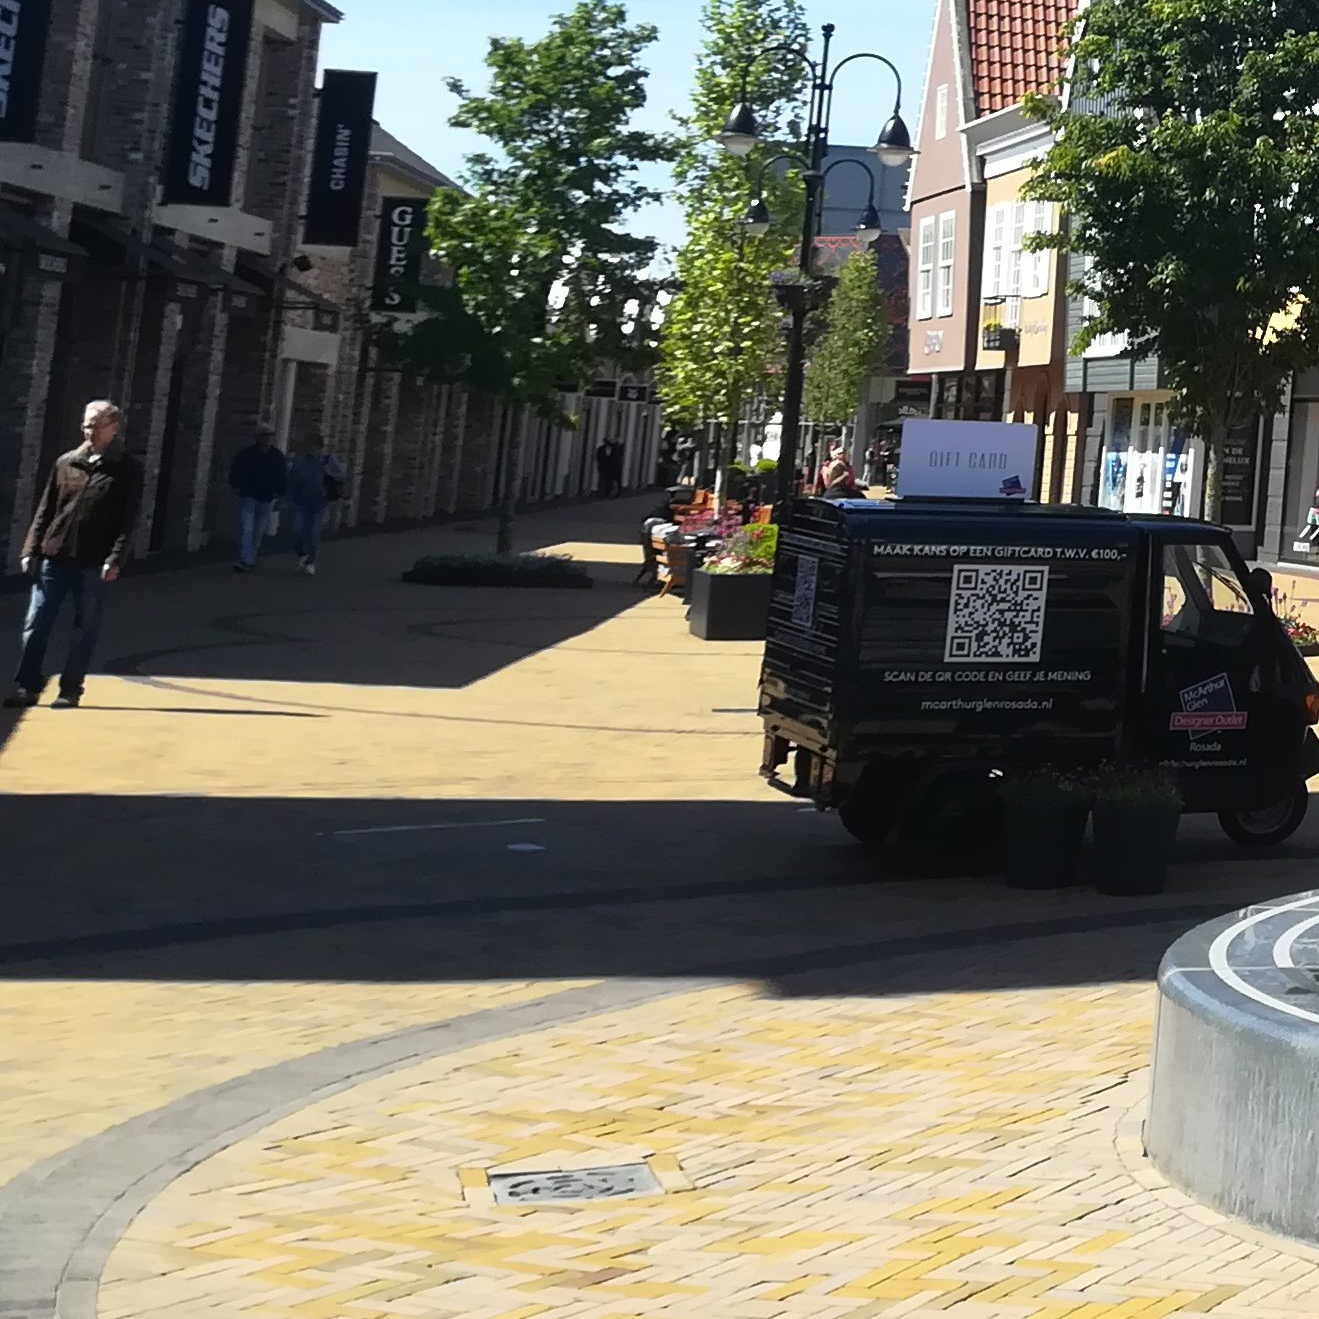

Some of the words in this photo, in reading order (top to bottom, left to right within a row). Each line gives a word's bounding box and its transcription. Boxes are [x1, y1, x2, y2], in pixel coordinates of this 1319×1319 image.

[188, 3, 230, 191] SKECHERS
[928, 449, 960, 468] GIFT
[968, 452, 1008, 470] CARD
[873, 544, 910, 556] MAAK
[913, 544, 948, 556] KANS
[950, 545, 969, 557] OP
[970, 545, 992, 557] EEN
[994, 546, 1053, 558] GIFTCARD
[1055, 548, 1089, 559] T.W.V.
[1091, 548, 1127, 561] €100,-
[884, 671, 915, 682] SCAN
[918, 671, 933, 682] DE
[935, 671, 951, 682] QR
[954, 671, 986, 682] CODE
[988, 671, 1003, 682] EN
[1005, 671, 1031, 682] GEEF
[1033, 670, 1046, 682] JE
[1047, 670, 1092, 682] MENING
[1184, 679, 1226, 702] McArthur
[921, 698, 1054, 712] mcarthurglenrosada.nl
[1186, 697, 1209, 712] Glen
[1174, 715, 1214, 728] Designer
[1215, 714, 1243, 725] Outlet
[1189, 741, 1222, 752] Rosada
